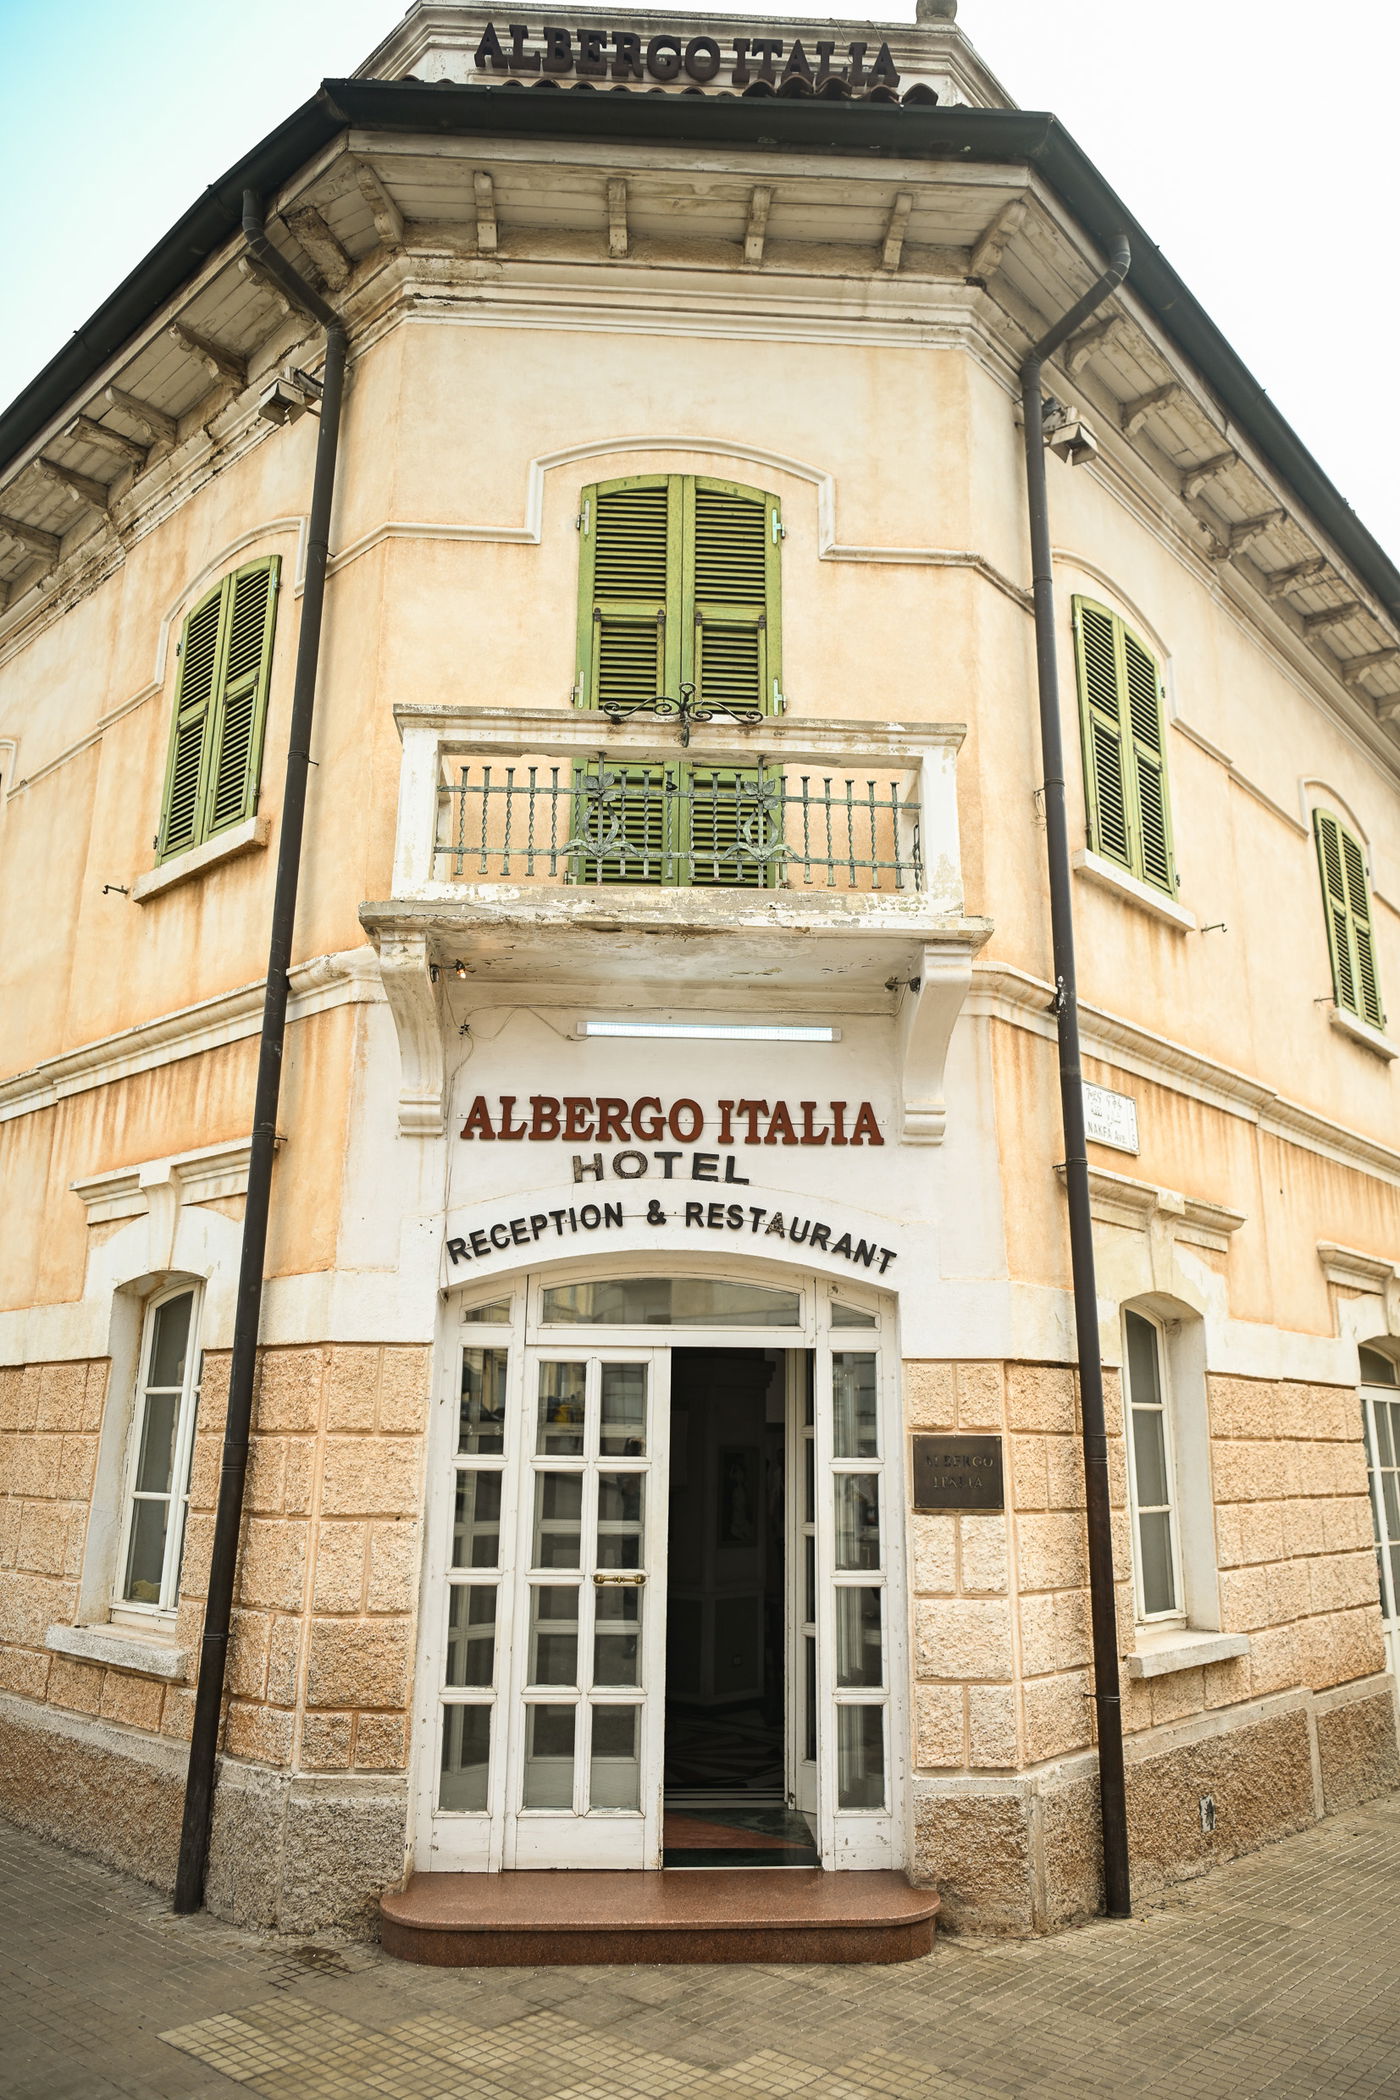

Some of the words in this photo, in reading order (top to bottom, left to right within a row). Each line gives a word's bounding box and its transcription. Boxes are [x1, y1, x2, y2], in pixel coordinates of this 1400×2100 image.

[474, 22, 721, 81] ALBERGO
[732, 38, 901, 87] ITALIA
[460, 1095, 704, 1143] ALBERGO
[717, 1099, 885, 1145] ITALIA
[572, 1150, 750, 1185] HOTEL
[446, 1201, 624, 1265] RECEPTION
[646, 1199, 667, 1225] &
[685, 1201, 898, 1274] RESTAURANT
